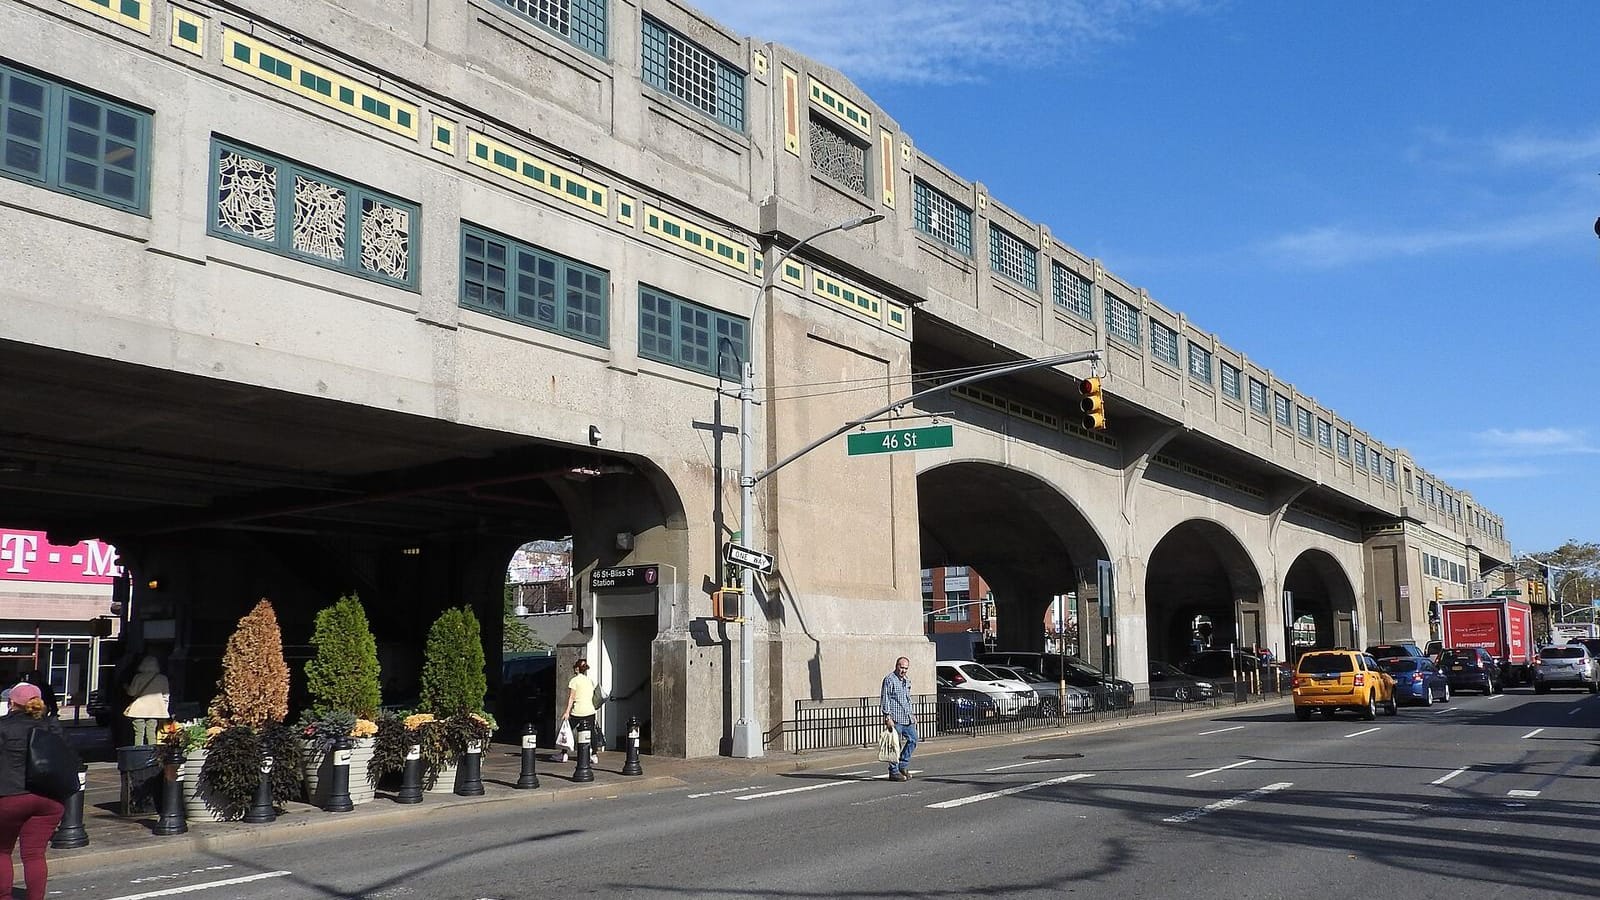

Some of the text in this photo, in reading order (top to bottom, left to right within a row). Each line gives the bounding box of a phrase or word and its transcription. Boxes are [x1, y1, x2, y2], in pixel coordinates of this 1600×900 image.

[882, 432, 917, 449] 46 St
[735, 551, 767, 566] ONE WAY
[592, 568, 634, 579] 46 St-Bliss St
[592, 579, 615, 587] Station
